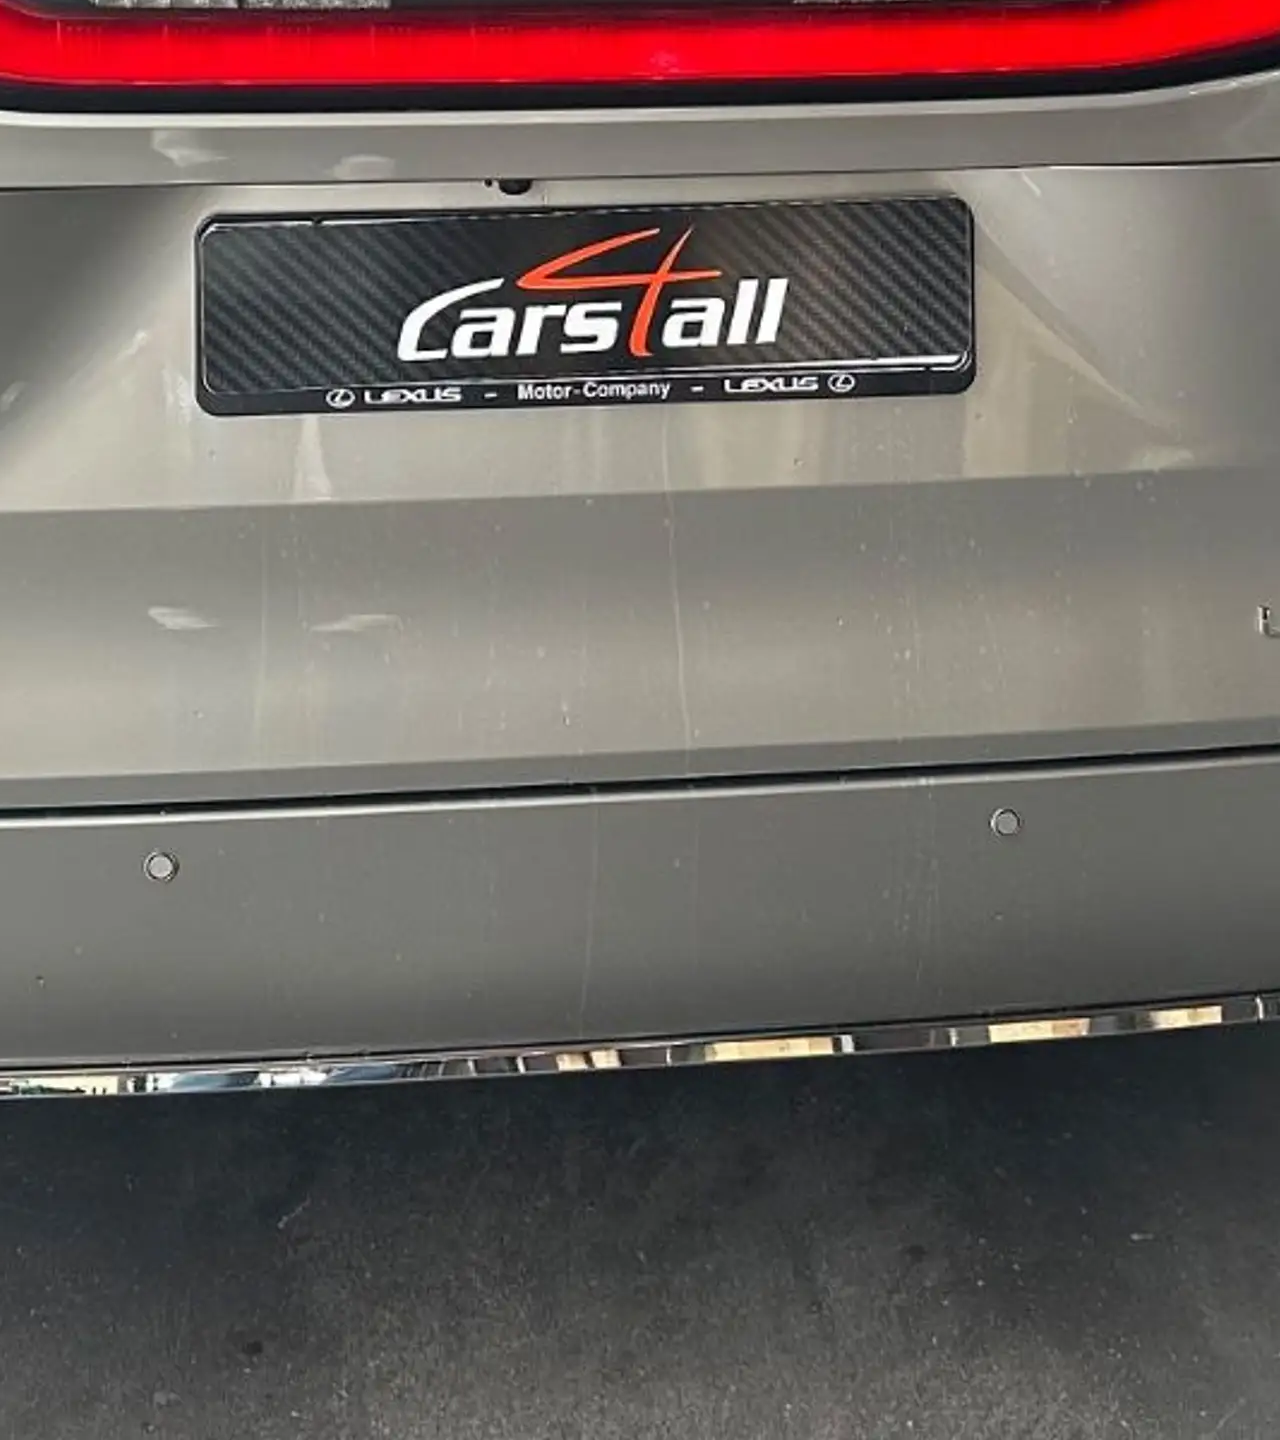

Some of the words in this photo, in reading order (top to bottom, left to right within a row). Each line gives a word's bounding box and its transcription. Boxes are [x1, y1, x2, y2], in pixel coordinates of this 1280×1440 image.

[396, 223, 789, 362] Cars4all
[363, 388, 462, 405] LEXUS
[517, 379, 672, 403] Motor-Company
[723, 374, 820, 393] LEXUS
